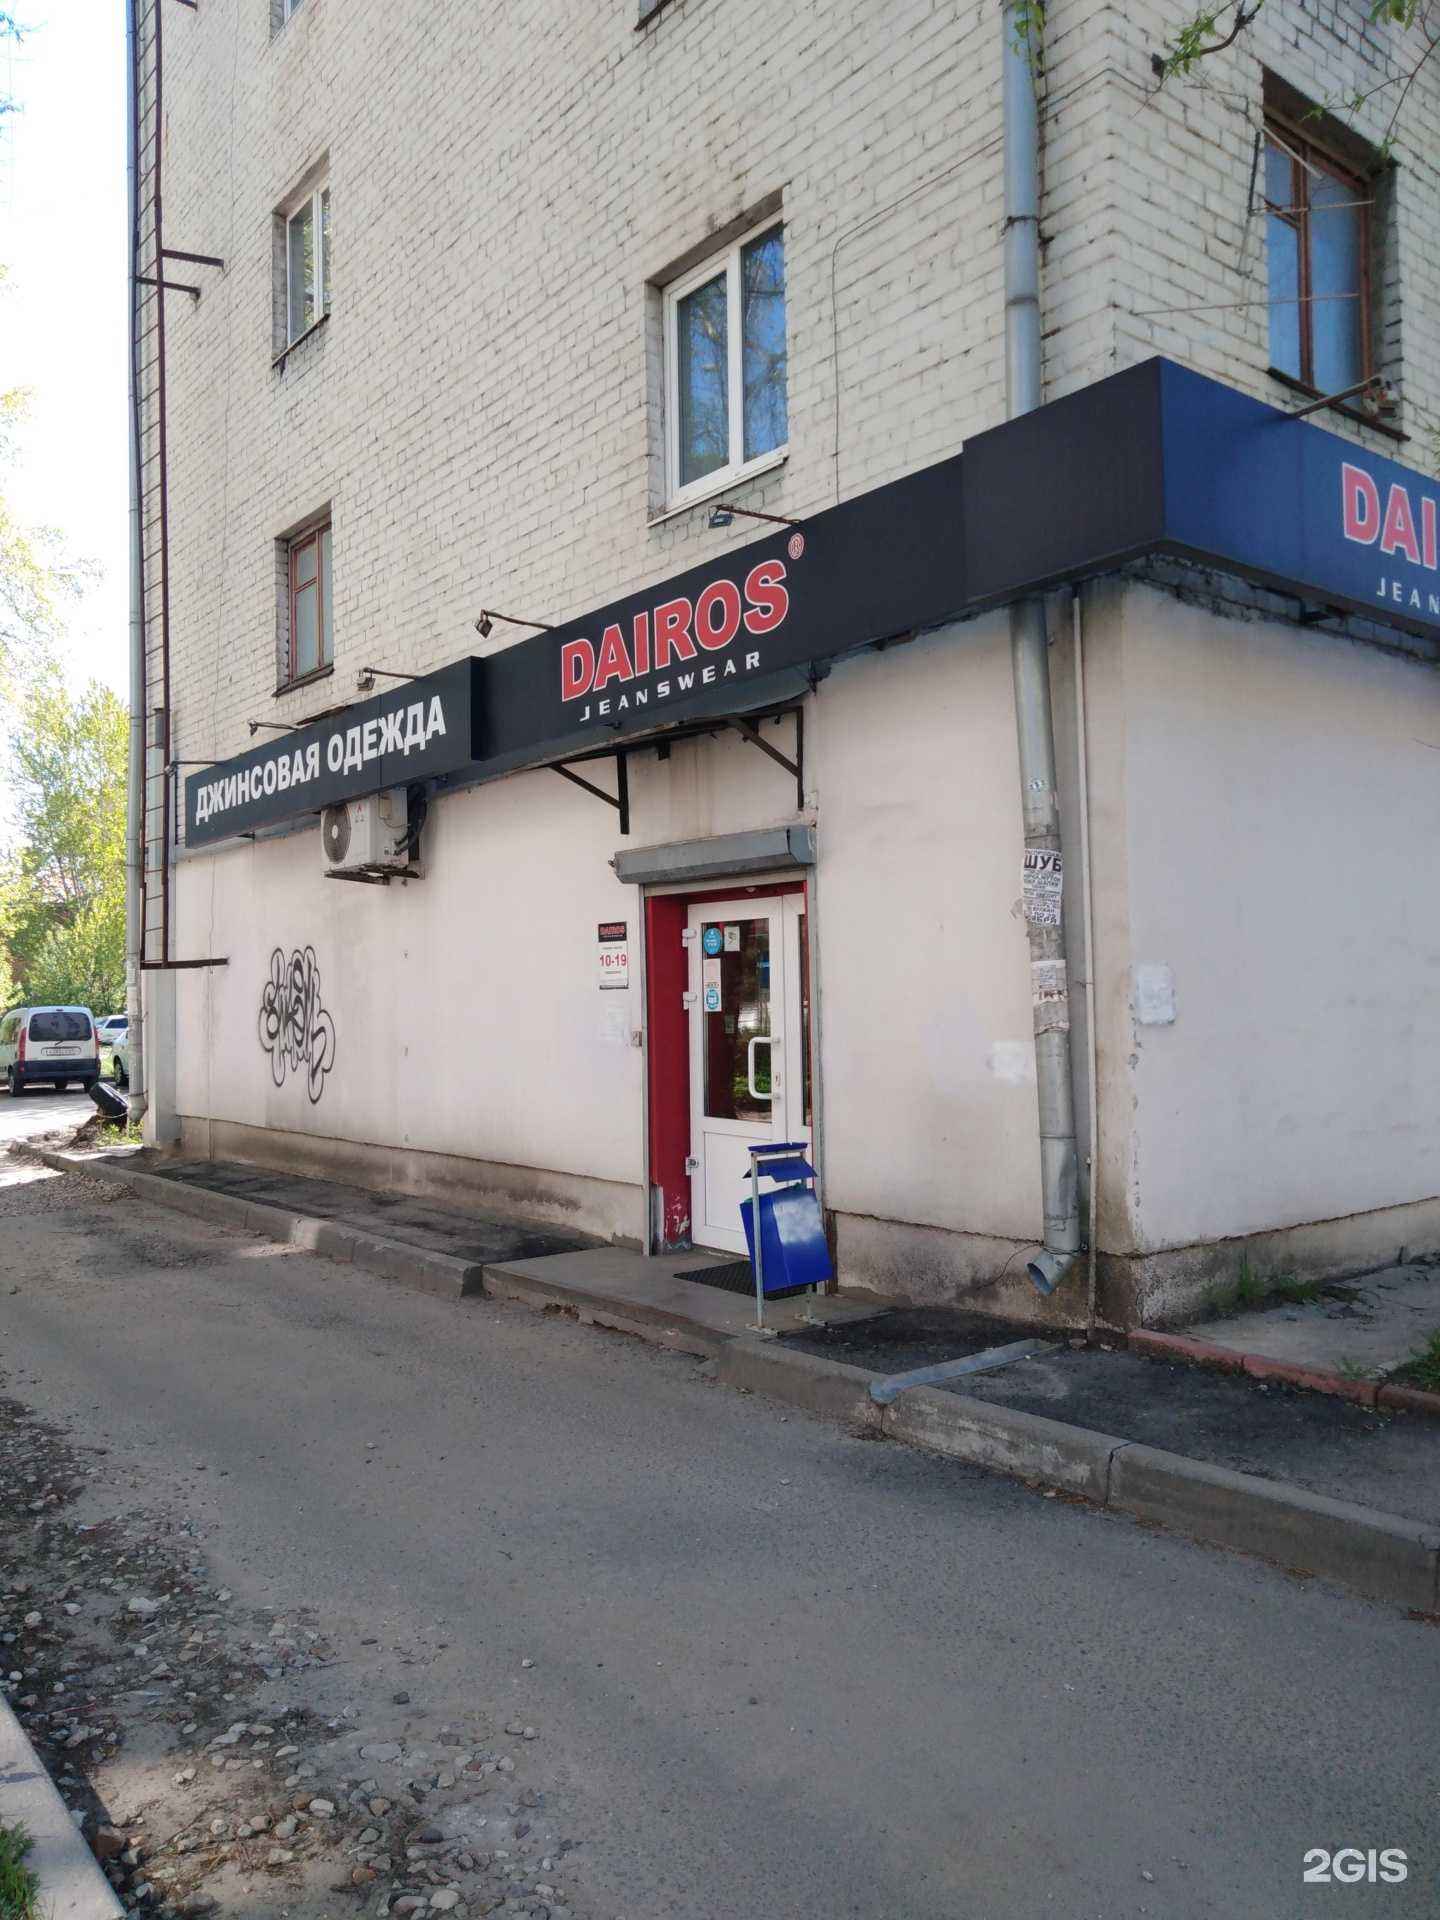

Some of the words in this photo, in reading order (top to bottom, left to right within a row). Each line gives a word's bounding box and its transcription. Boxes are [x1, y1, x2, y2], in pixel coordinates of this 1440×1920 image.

[561, 559, 789, 702] DAIROS
[579, 651, 761, 722] JEANSWEAR
[195, 742, 320, 826] ДЖИНСОВАЯ
[327, 695, 447, 775] ОДЕЖДА
[1024, 855, 1062, 872] ШУБ
[599, 953, 627, 967] 10-19
